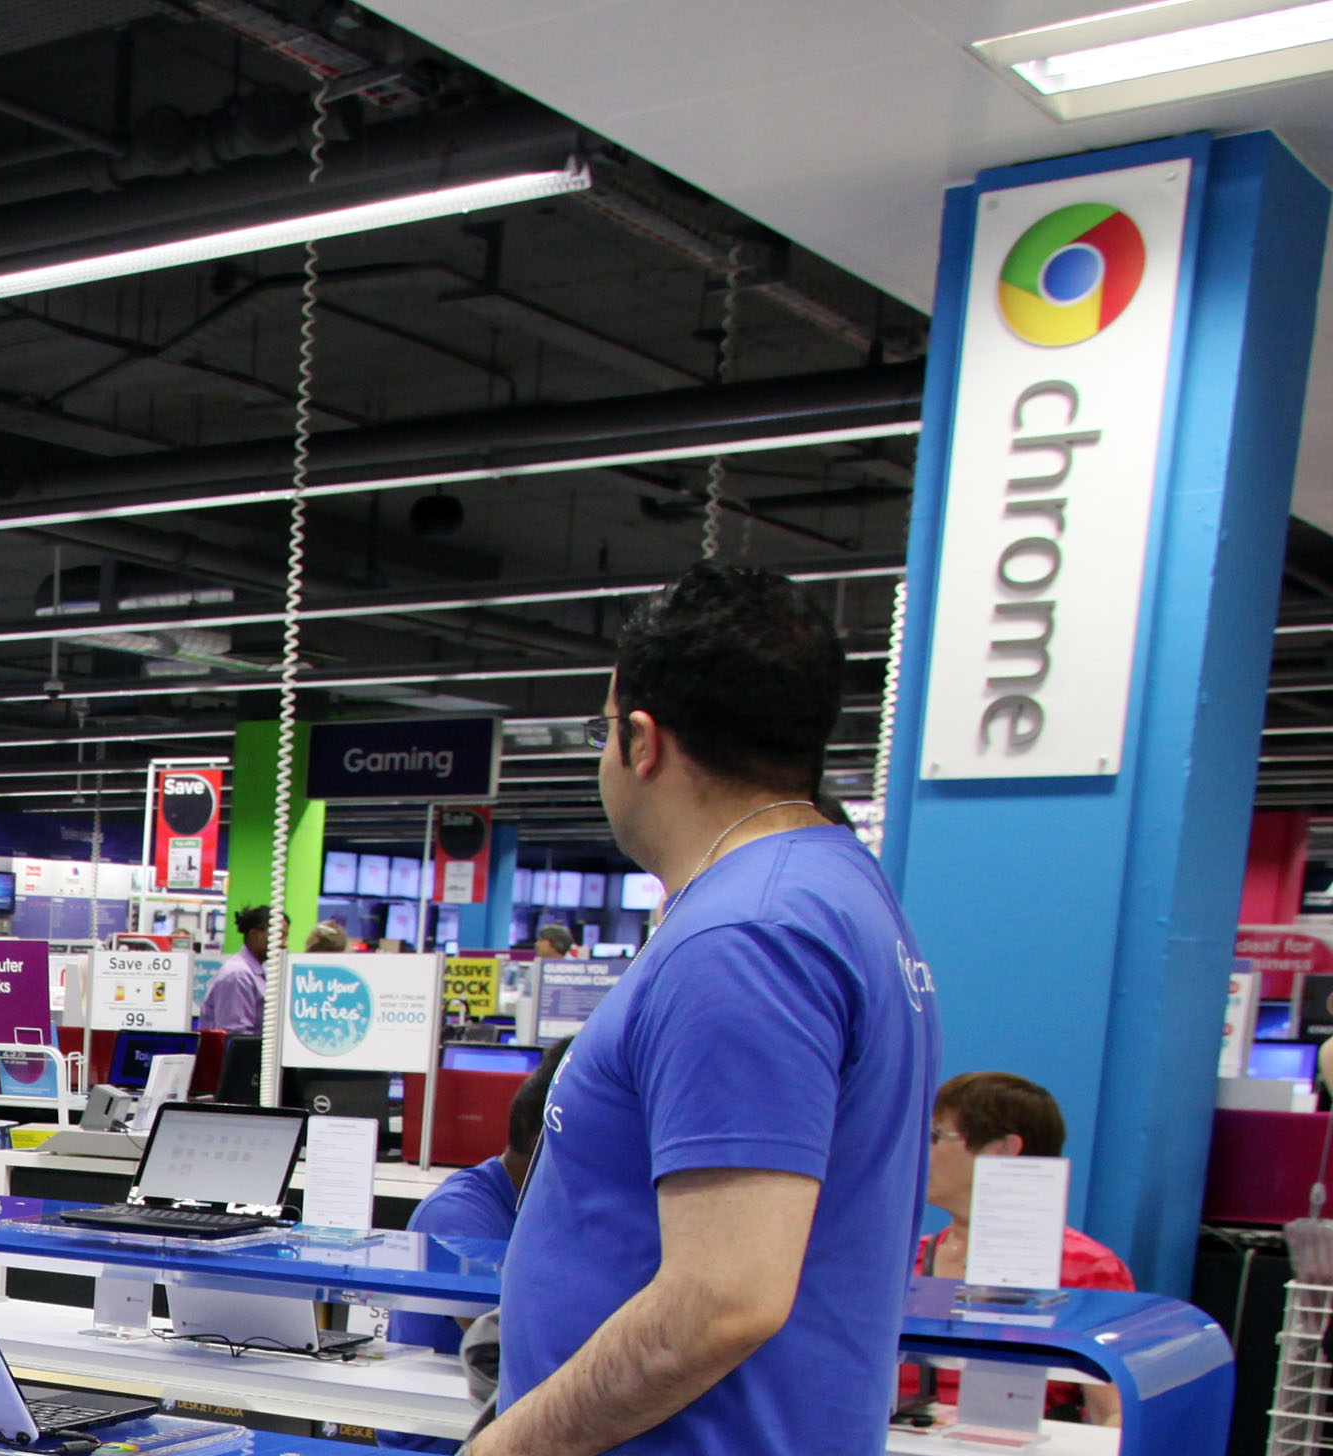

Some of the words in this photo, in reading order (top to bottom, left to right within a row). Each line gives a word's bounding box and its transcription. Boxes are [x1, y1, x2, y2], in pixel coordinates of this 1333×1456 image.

[977, 379, 1102, 758] chrome
[343, 746, 454, 779] Gaming
[163, 778, 205, 795] Save
[109, 957, 143, 970] Save
[445, 964, 492, 977] ASSIVE
[295, 970, 324, 994] Win
[326, 977, 361, 1002] your
[444, 980, 490, 995] TOCK
[294, 1001, 318, 1020] Uni
[319, 1001, 360, 1020] fees
